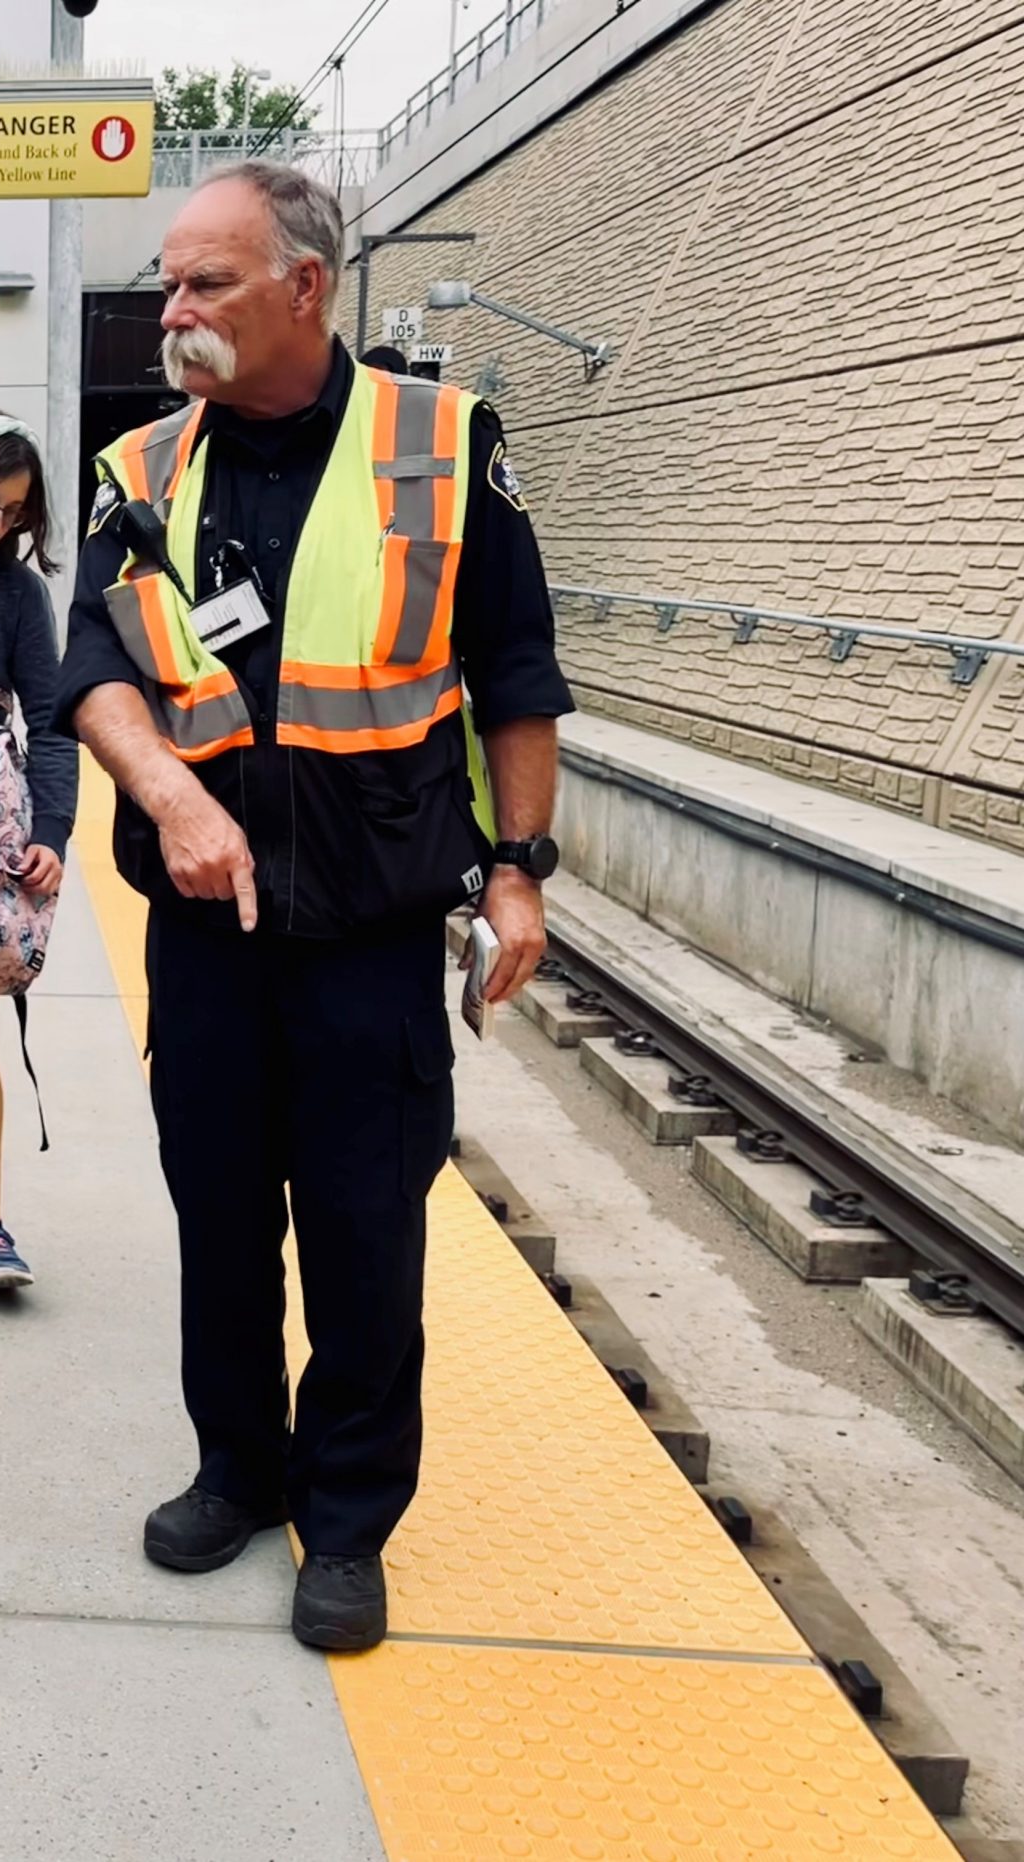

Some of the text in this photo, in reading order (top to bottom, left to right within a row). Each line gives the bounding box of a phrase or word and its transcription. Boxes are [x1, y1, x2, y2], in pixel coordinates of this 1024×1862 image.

[25, 143, 59, 159] Back
[64, 142, 78, 158] of
[47, 167, 77, 181] Line
[399, 310, 408, 322] D
[390, 325, 416, 338] 105
[419, 347, 445, 359] HW
